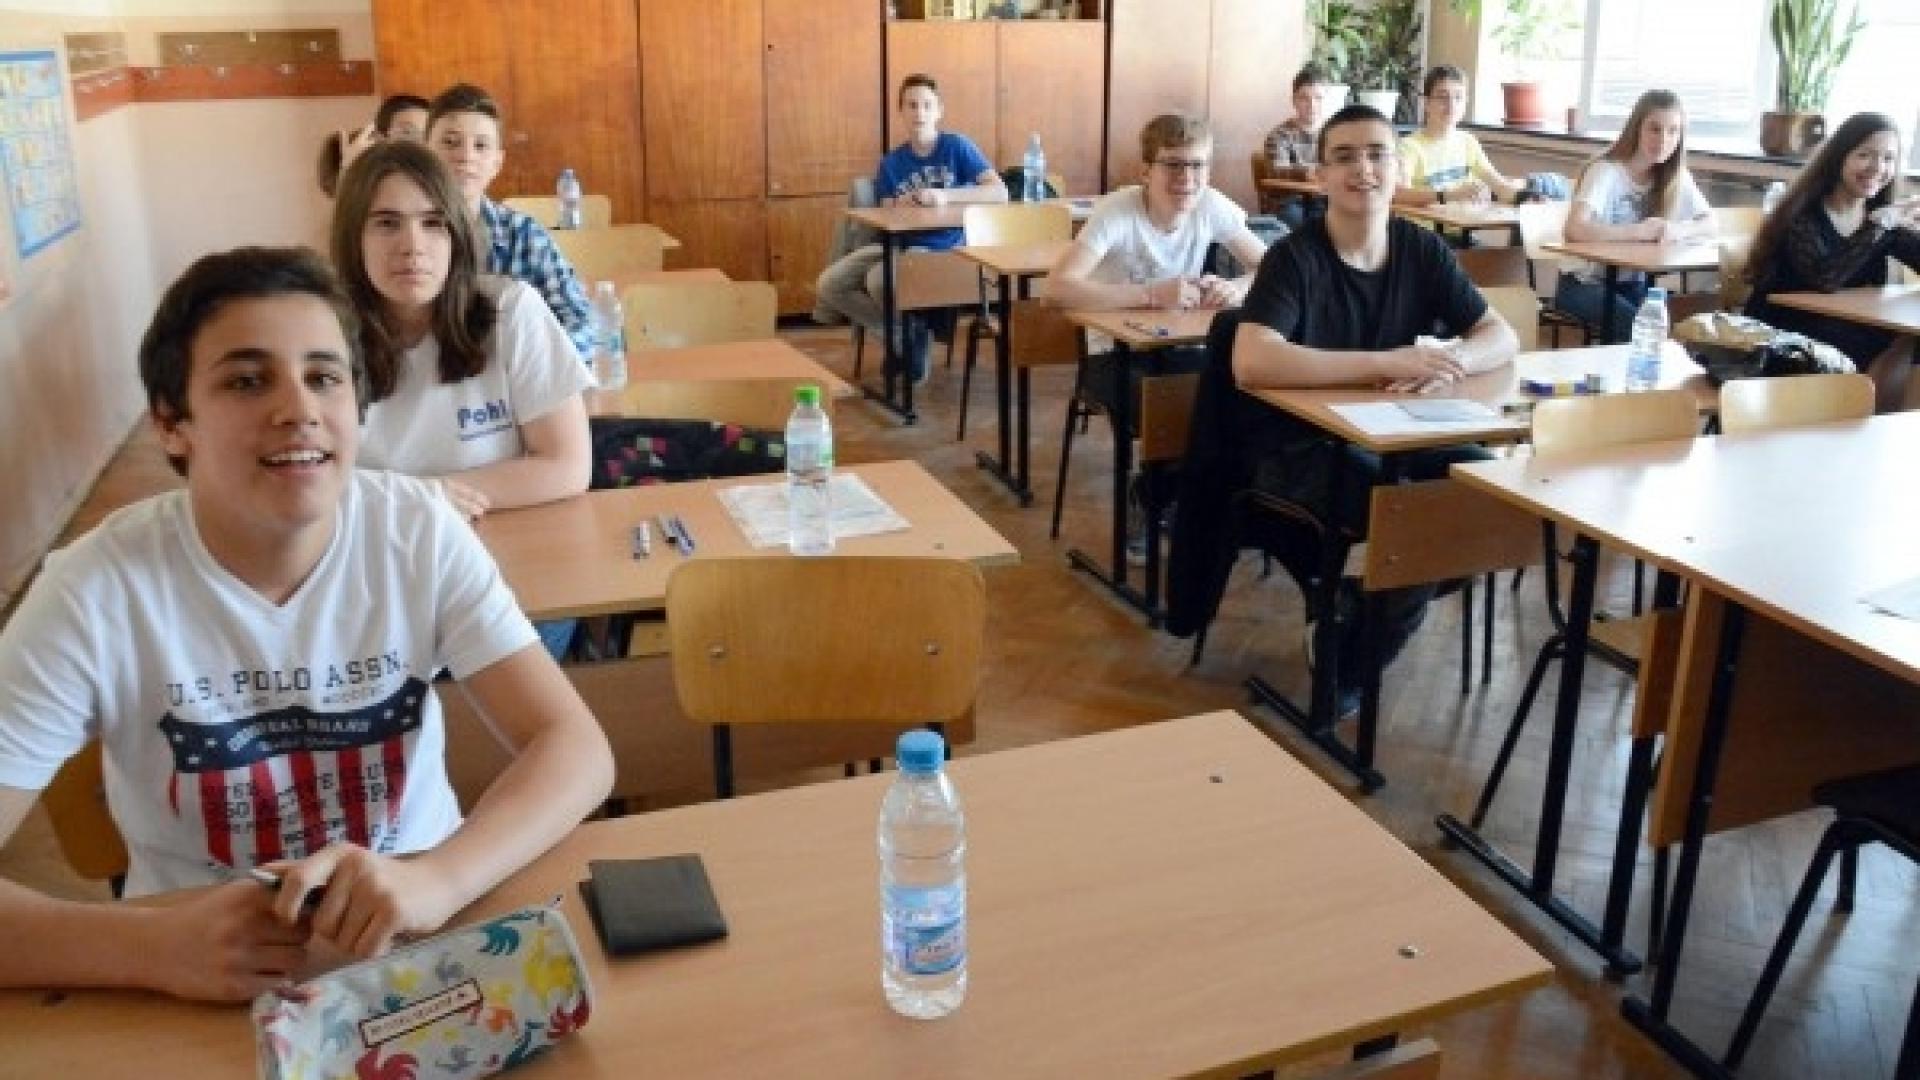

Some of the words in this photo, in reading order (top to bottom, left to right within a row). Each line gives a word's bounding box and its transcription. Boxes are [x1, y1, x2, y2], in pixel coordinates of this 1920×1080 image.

[166, 677, 224, 706] U.S.
[232, 667, 312, 694] POLO
[325, 650, 410, 688] ASSN.
